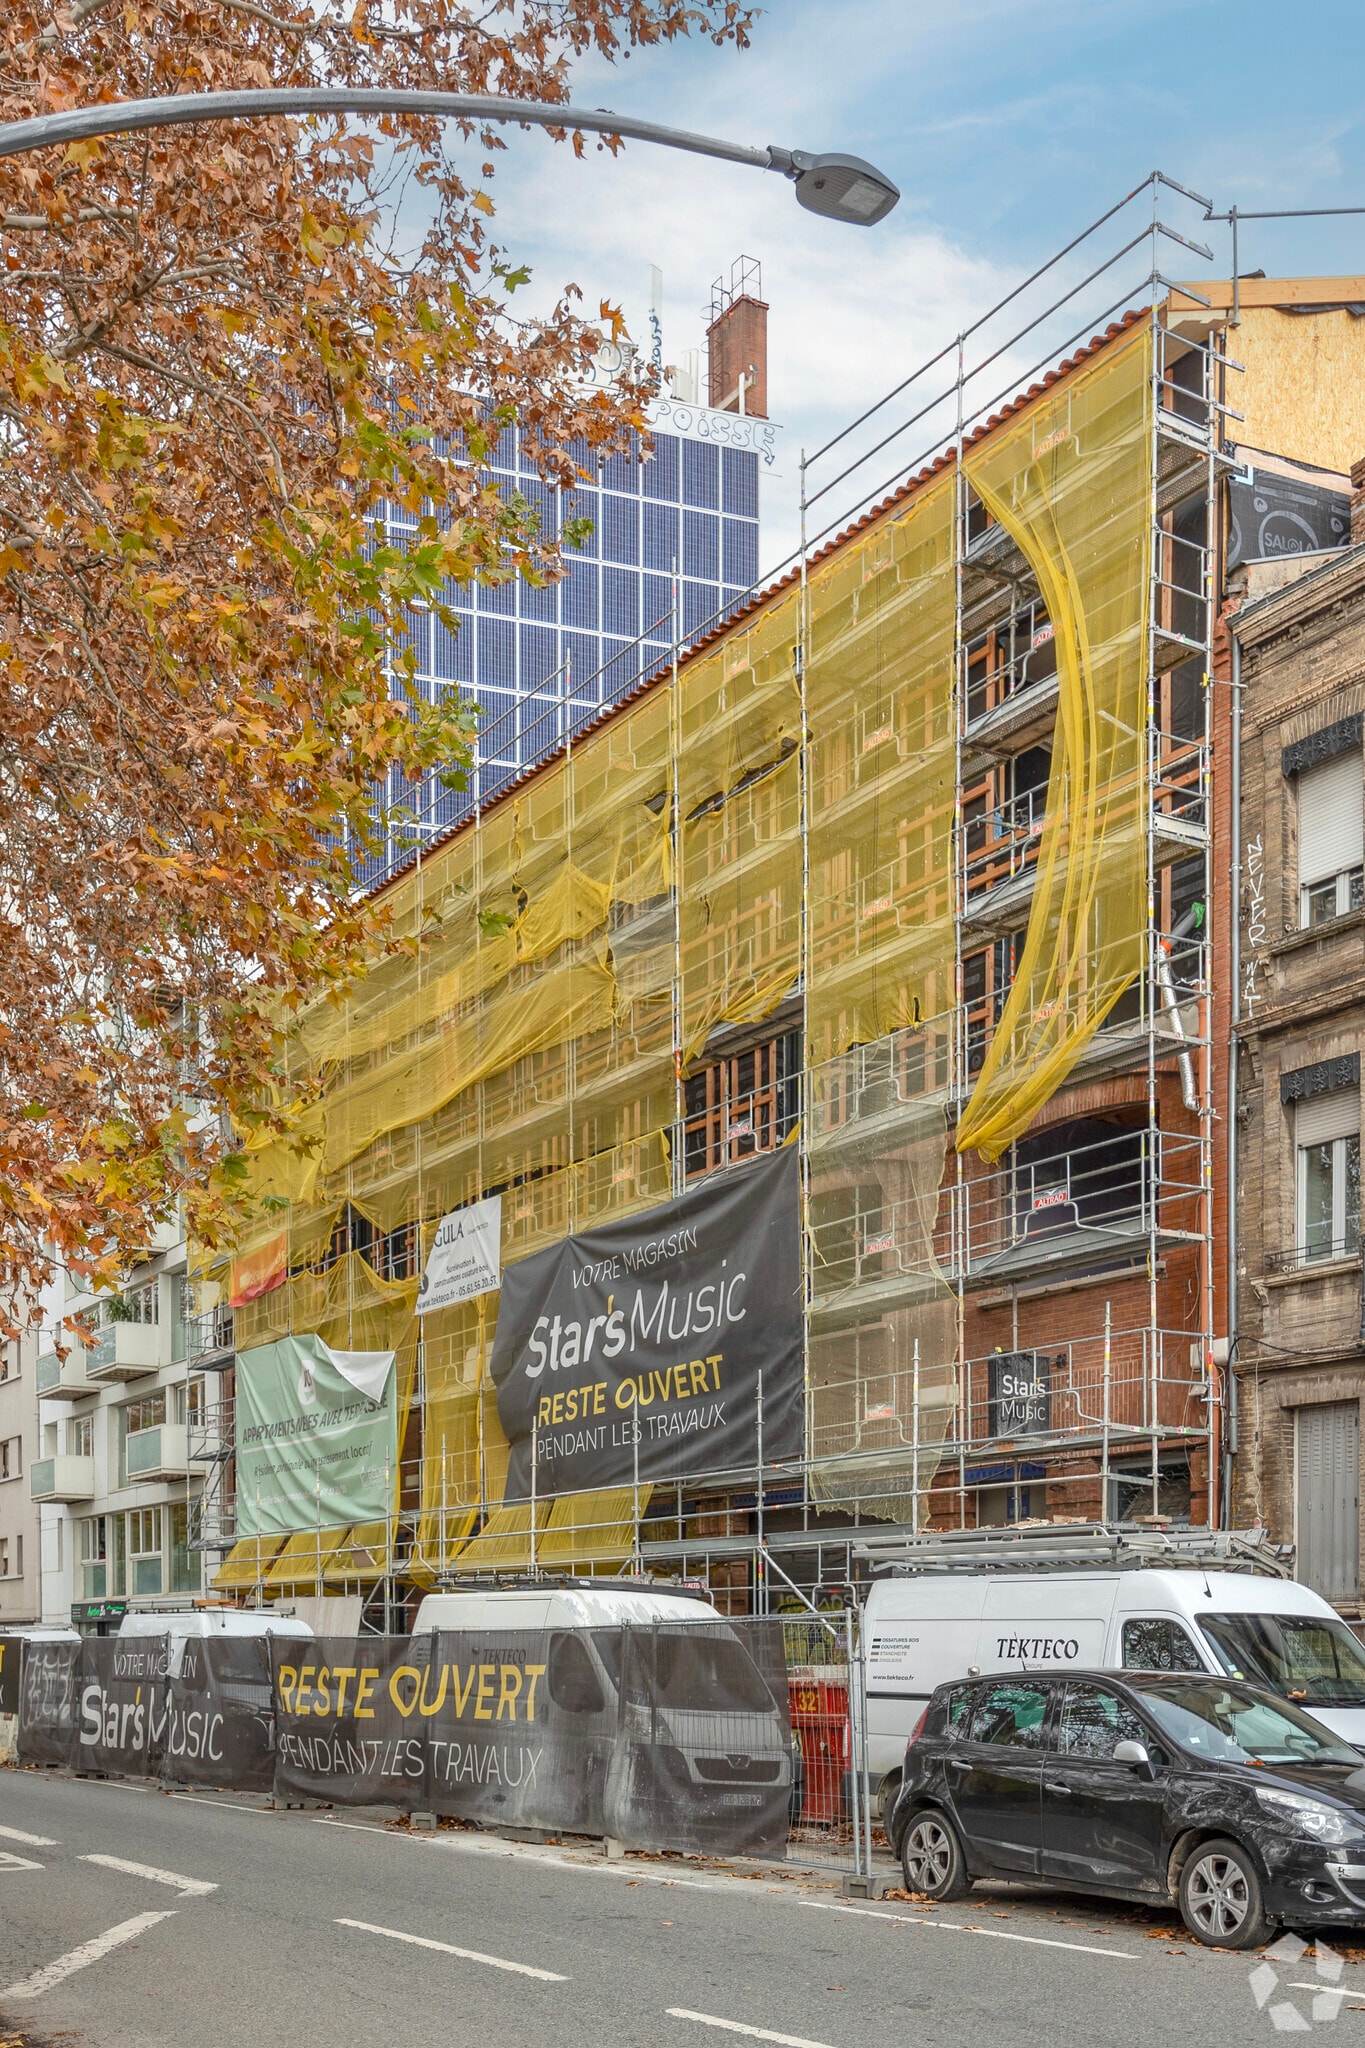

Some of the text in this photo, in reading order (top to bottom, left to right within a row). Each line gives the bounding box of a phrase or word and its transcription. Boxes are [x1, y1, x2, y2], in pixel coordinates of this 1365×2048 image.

[1037, 1193, 1064, 1207] ALTRAD
[573, 1225, 698, 1289] VOTRE MAGASIN
[538, 1354, 724, 1428] RESTE OUVERT
[319, 1408, 345, 1428] AVEC
[344, 1392, 388, 1421] TERRSE
[1002, 1400, 1046, 1420] Music
[537, 1401, 727, 1462] PENDANT LES TRAVAUX
[114, 1654, 197, 1678] VOTRE MAGIN
[483, 1648, 526, 1664] TEKTECO
[997, 1638, 1079, 1659] TEKTECO
[279, 1664, 547, 1721] RESTE OUVERT
[280, 1733, 543, 1788] PENDANT LES TRAVAUX
